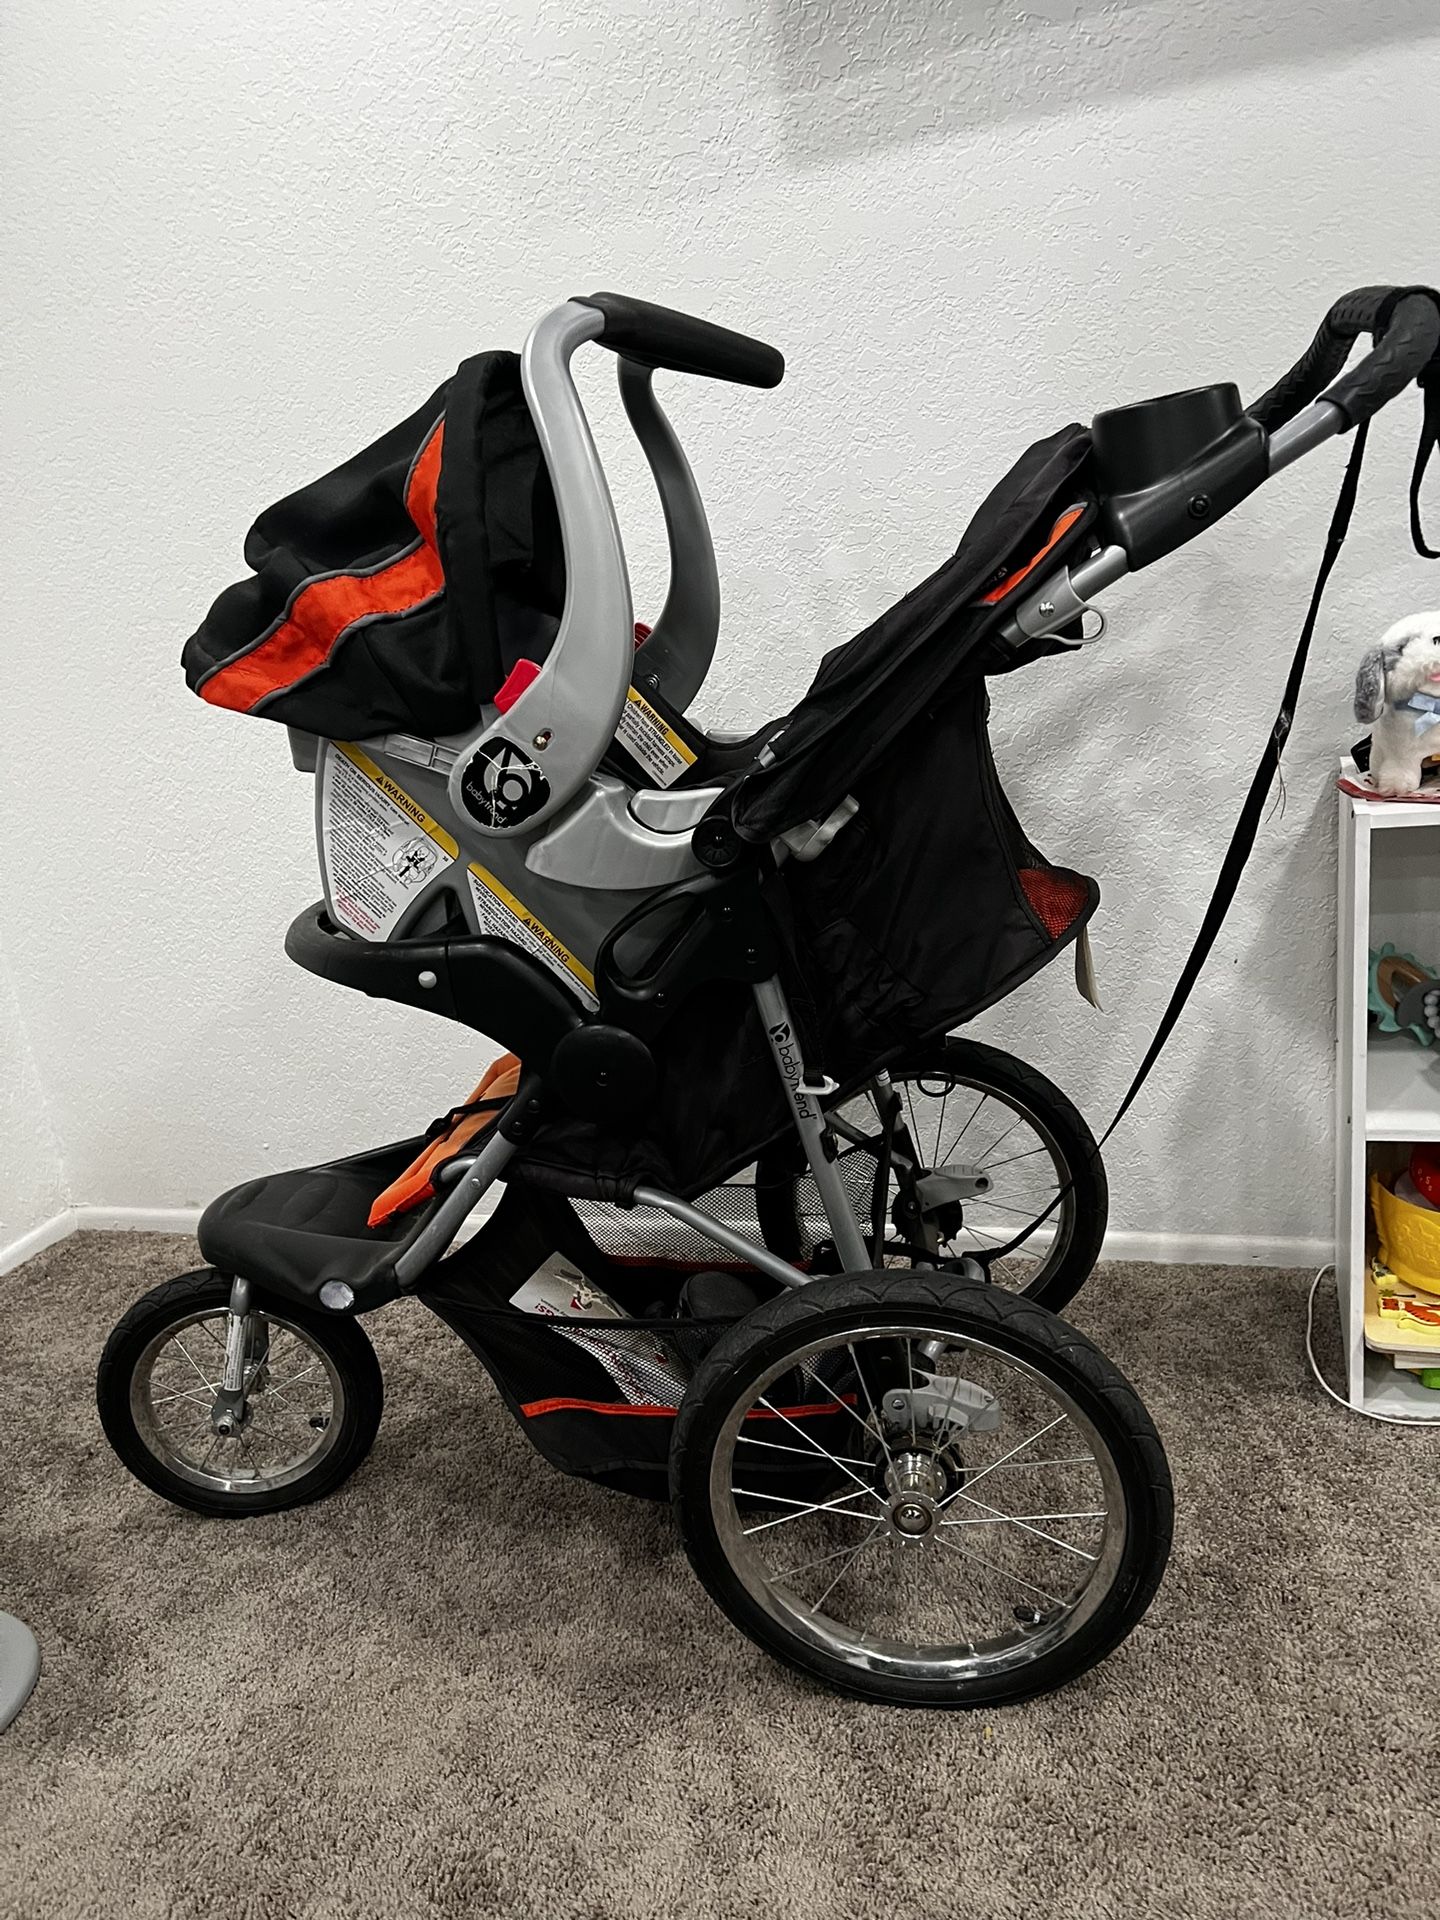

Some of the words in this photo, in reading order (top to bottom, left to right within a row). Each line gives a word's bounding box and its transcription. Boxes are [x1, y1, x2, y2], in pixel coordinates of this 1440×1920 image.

[638, 703, 669, 736] WARNING
[647, 726, 671, 751] STRANGLED
[381, 780, 426, 823] WARNING
[529, 922, 570, 963] WARNING
